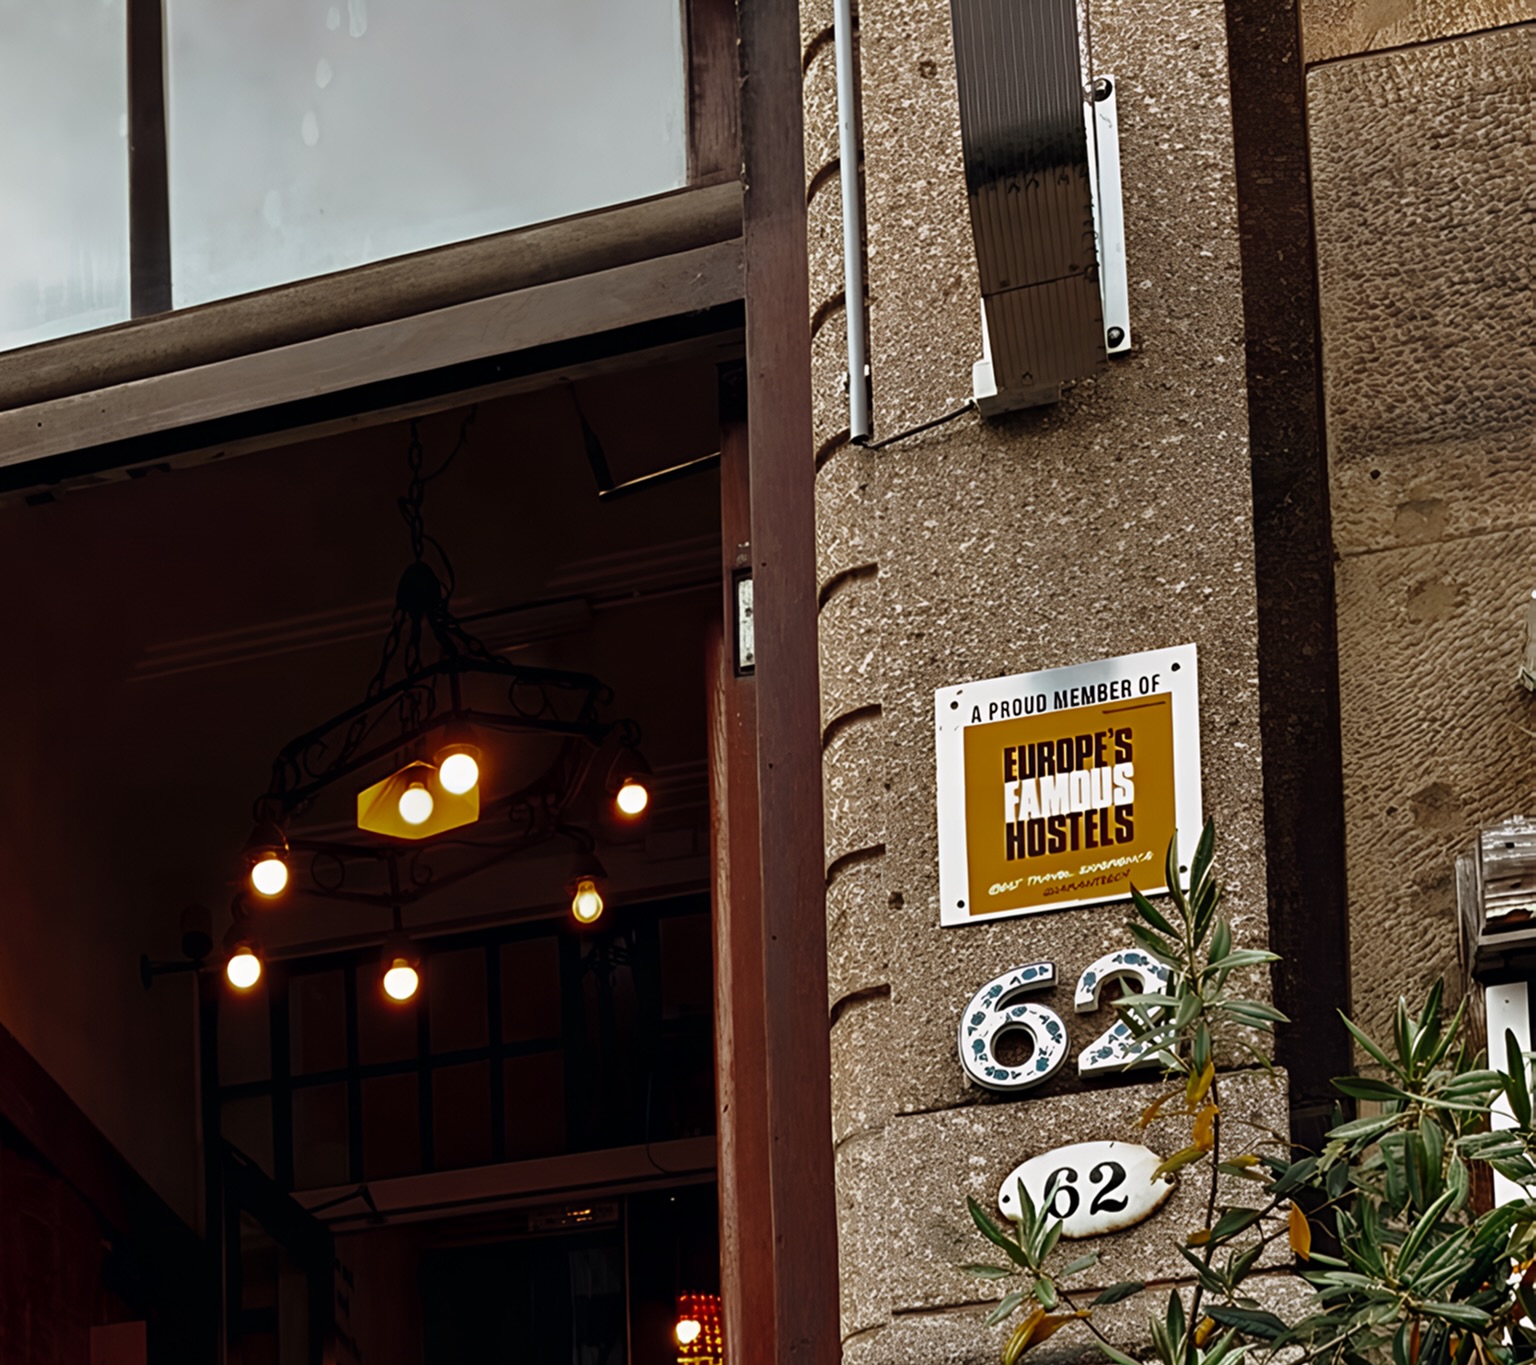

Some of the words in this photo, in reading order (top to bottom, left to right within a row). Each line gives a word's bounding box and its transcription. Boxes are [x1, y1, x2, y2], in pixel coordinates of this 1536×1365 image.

[971, 705, 982, 723] A
[988, 694, 1047, 721] PROUD
[1053, 679, 1132, 709] MEMBER
[1139, 674, 1161, 695] OF
[1003, 727, 1133, 783] EUROPE'S
[1004, 762, 1135, 823] FAMOUS
[1006, 803, 1134, 862] HOSTELS
[958, 949, 1176, 1091] 62
[1043, 1160, 1129, 1219] 62
